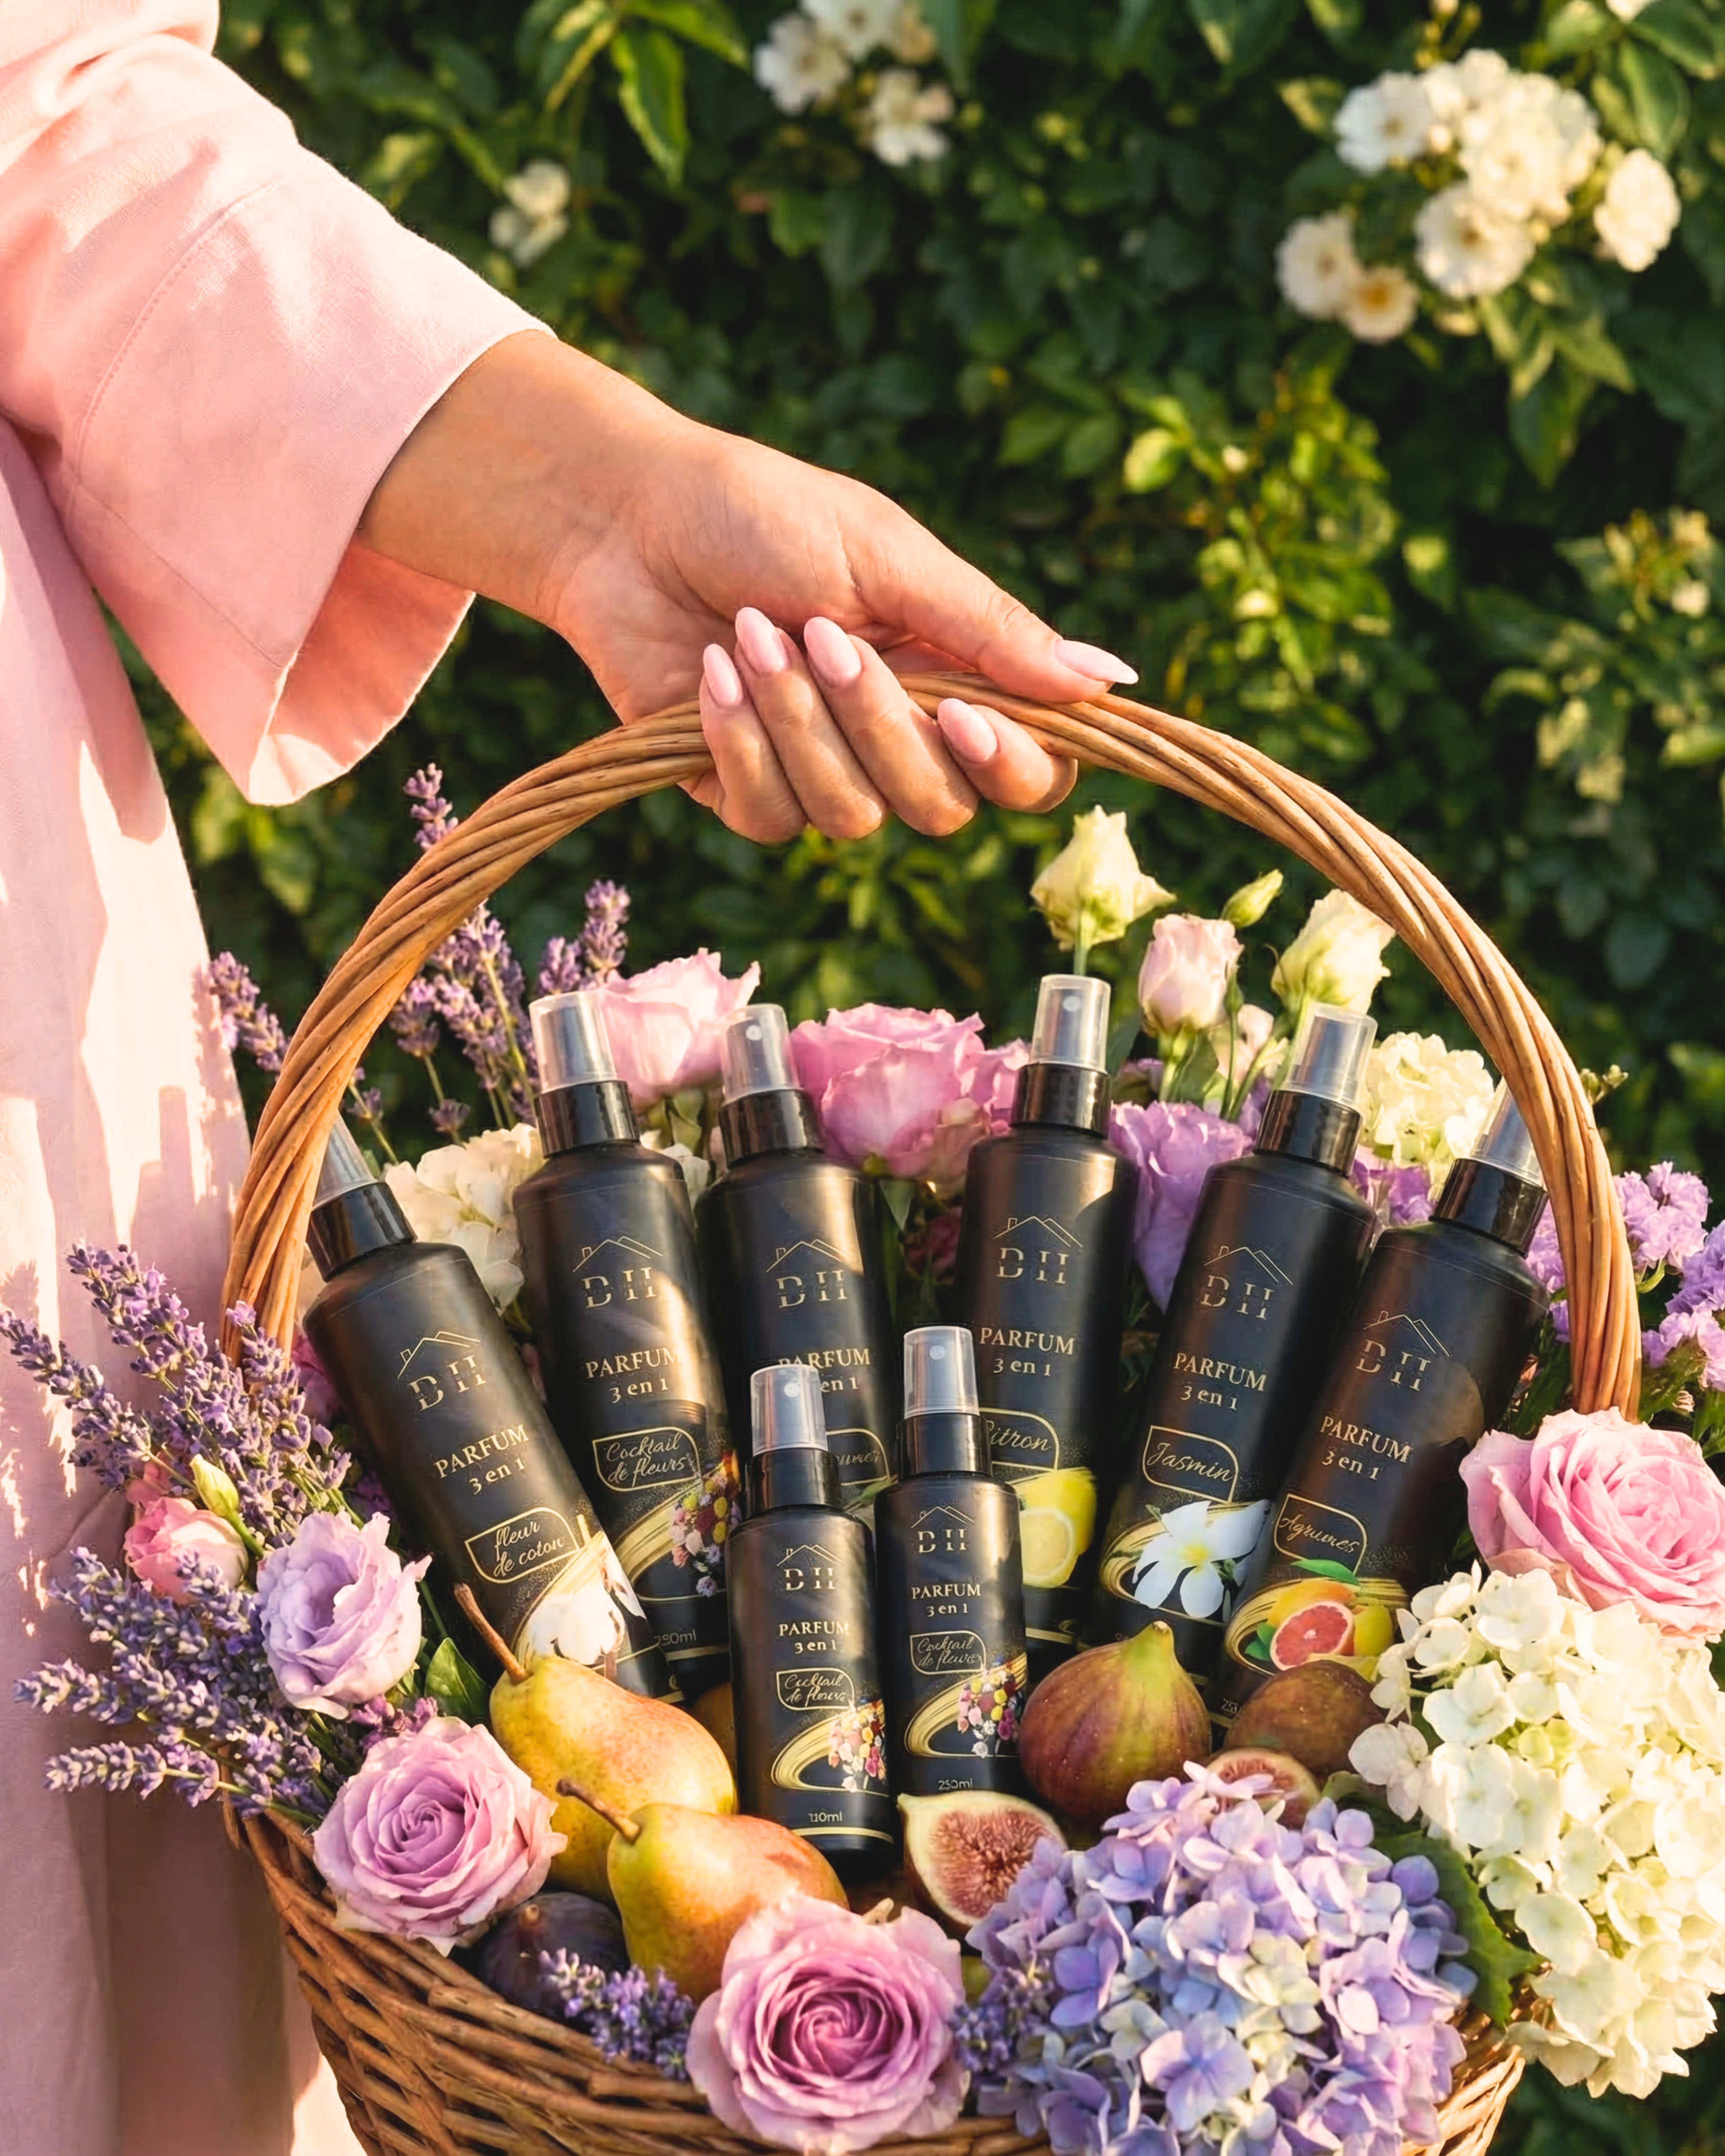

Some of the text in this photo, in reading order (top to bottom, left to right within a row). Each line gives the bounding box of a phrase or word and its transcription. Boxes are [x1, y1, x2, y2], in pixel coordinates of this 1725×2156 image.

[979, 1327, 1075, 1355] PARFUM
[585, 1347, 681, 1379] PARFUM
[993, 1358, 1004, 1373] 3
[1010, 1360, 1036, 1374] en
[1173, 1352, 1267, 1392] PARFUM
[609, 1387, 621, 1403] 3
[627, 1380, 653, 1396] en
[820, 1379, 844, 1393] en
[1180, 1385, 1191, 1401] 3
[1197, 1389, 1222, 1406] en
[433, 1424, 529, 1478] PARFUM
[607, 1431, 682, 1462] Cocktail
[1319, 1415, 1412, 1464] PARFUM
[632, 1455, 686, 1488] fleurs
[1146, 1441, 1235, 1482] Jasmin
[1322, 1450, 1334, 1466] 3
[1338, 1455, 1363, 1474] en
[469, 1477, 482, 1495] 3
[485, 1463, 512, 1483] en
[494, 1521, 540, 1562] fleur
[494, 1537, 565, 1577] de coton
[911, 1583, 981, 1599] PARFUM
[926, 1606, 935, 1617] 3
[938, 1604, 957, 1615] en
[779, 1621, 849, 1637] PARFUM
[807, 1640, 826, 1651] en
